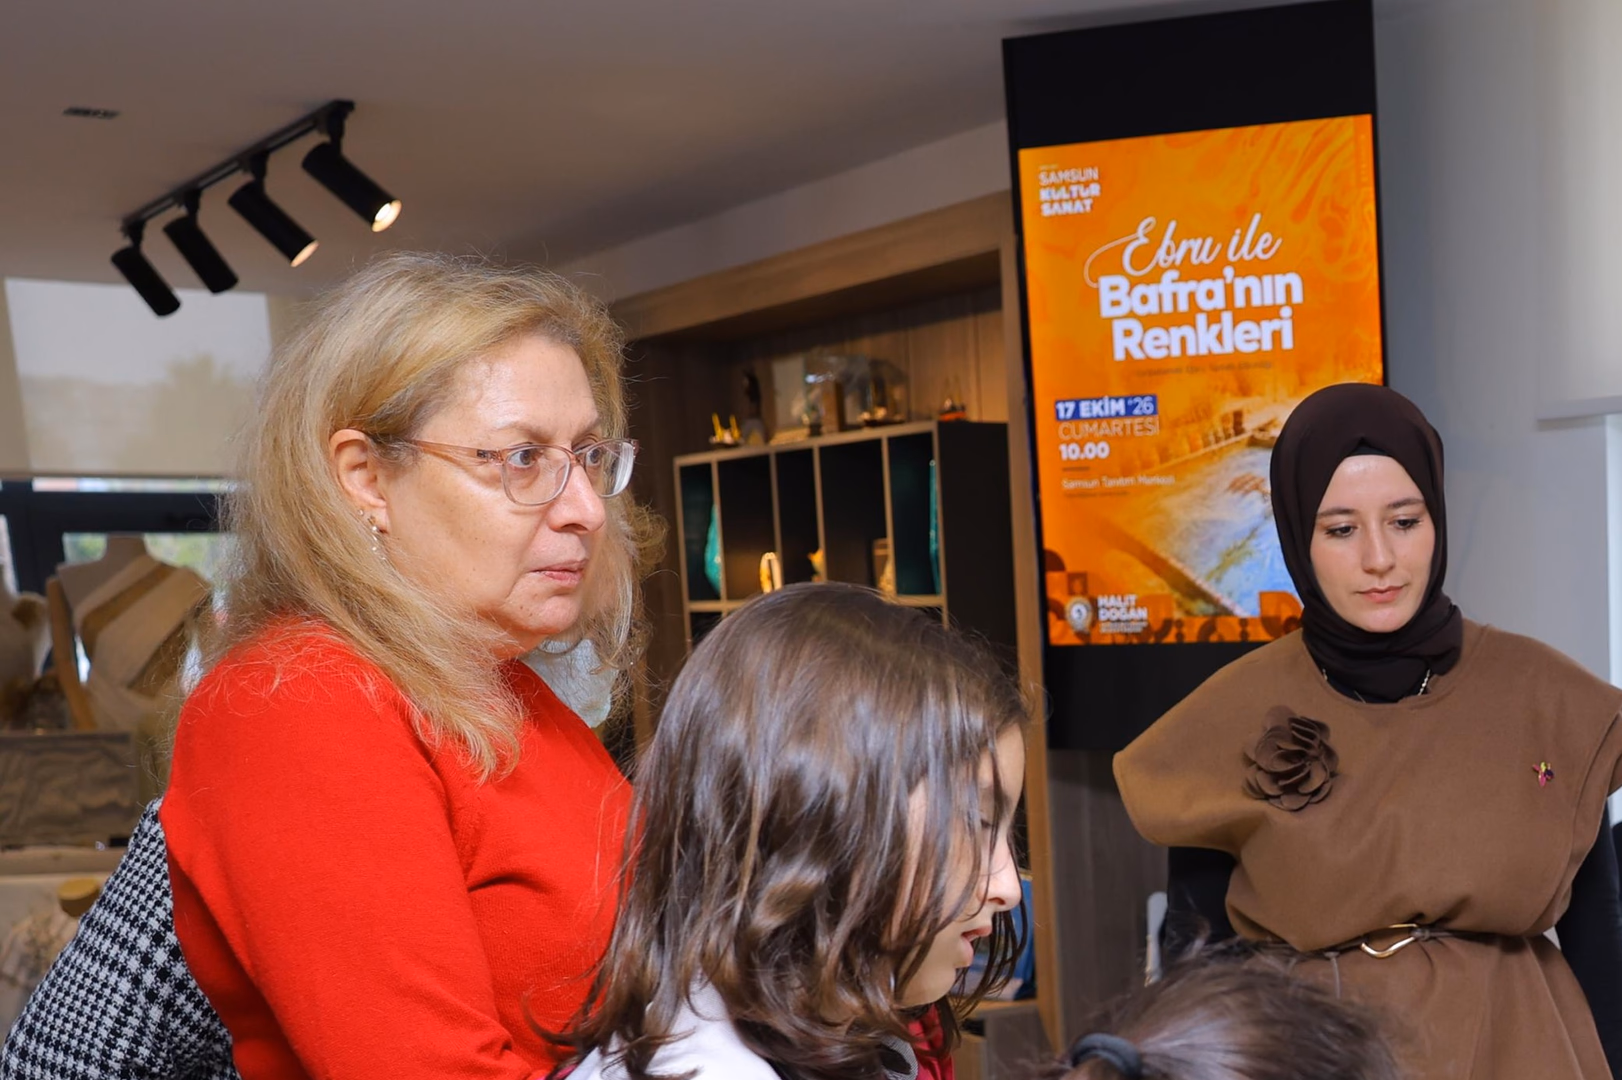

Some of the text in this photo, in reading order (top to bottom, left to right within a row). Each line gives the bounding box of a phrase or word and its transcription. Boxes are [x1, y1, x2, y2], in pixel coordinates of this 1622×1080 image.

[1039, 167, 1099, 186] SAMSUN
[1040, 198, 1093, 217] SANAT
[1084, 212, 1282, 288] Ebru ile
[1098, 266, 1303, 318] Bafra'nın
[1112, 306, 1294, 361] Renkleri
[1056, 401, 1076, 420] 17
[1080, 396, 1126, 419] EKİM
[1059, 441, 1110, 461] 10.00
